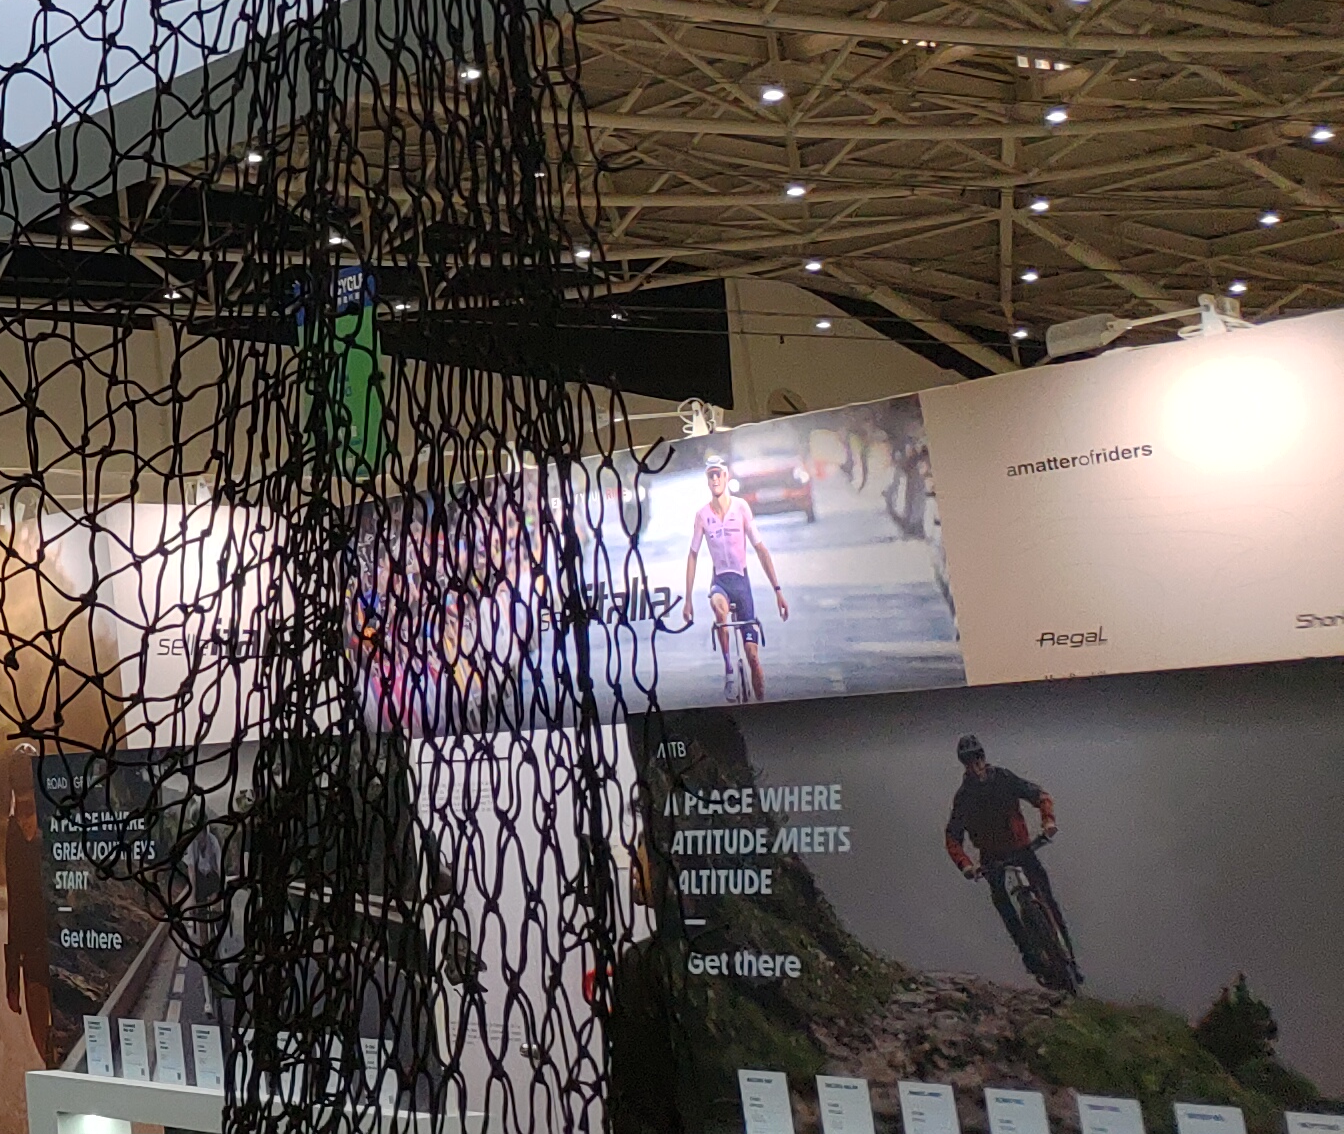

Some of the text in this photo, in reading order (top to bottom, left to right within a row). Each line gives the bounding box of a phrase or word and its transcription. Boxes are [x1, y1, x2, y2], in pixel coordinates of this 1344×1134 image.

[1006, 443, 1153, 478] amatterofriders
[684, 787, 753, 816] PLACE
[759, 784, 842, 813] WHERE
[670, 826, 851, 855] ATTITUDE MEETS
[55, 870, 89, 891] START
[679, 868, 772, 895] ALTITUDE
[60, 928, 123, 950] Get there
[687, 950, 802, 978] Get there
